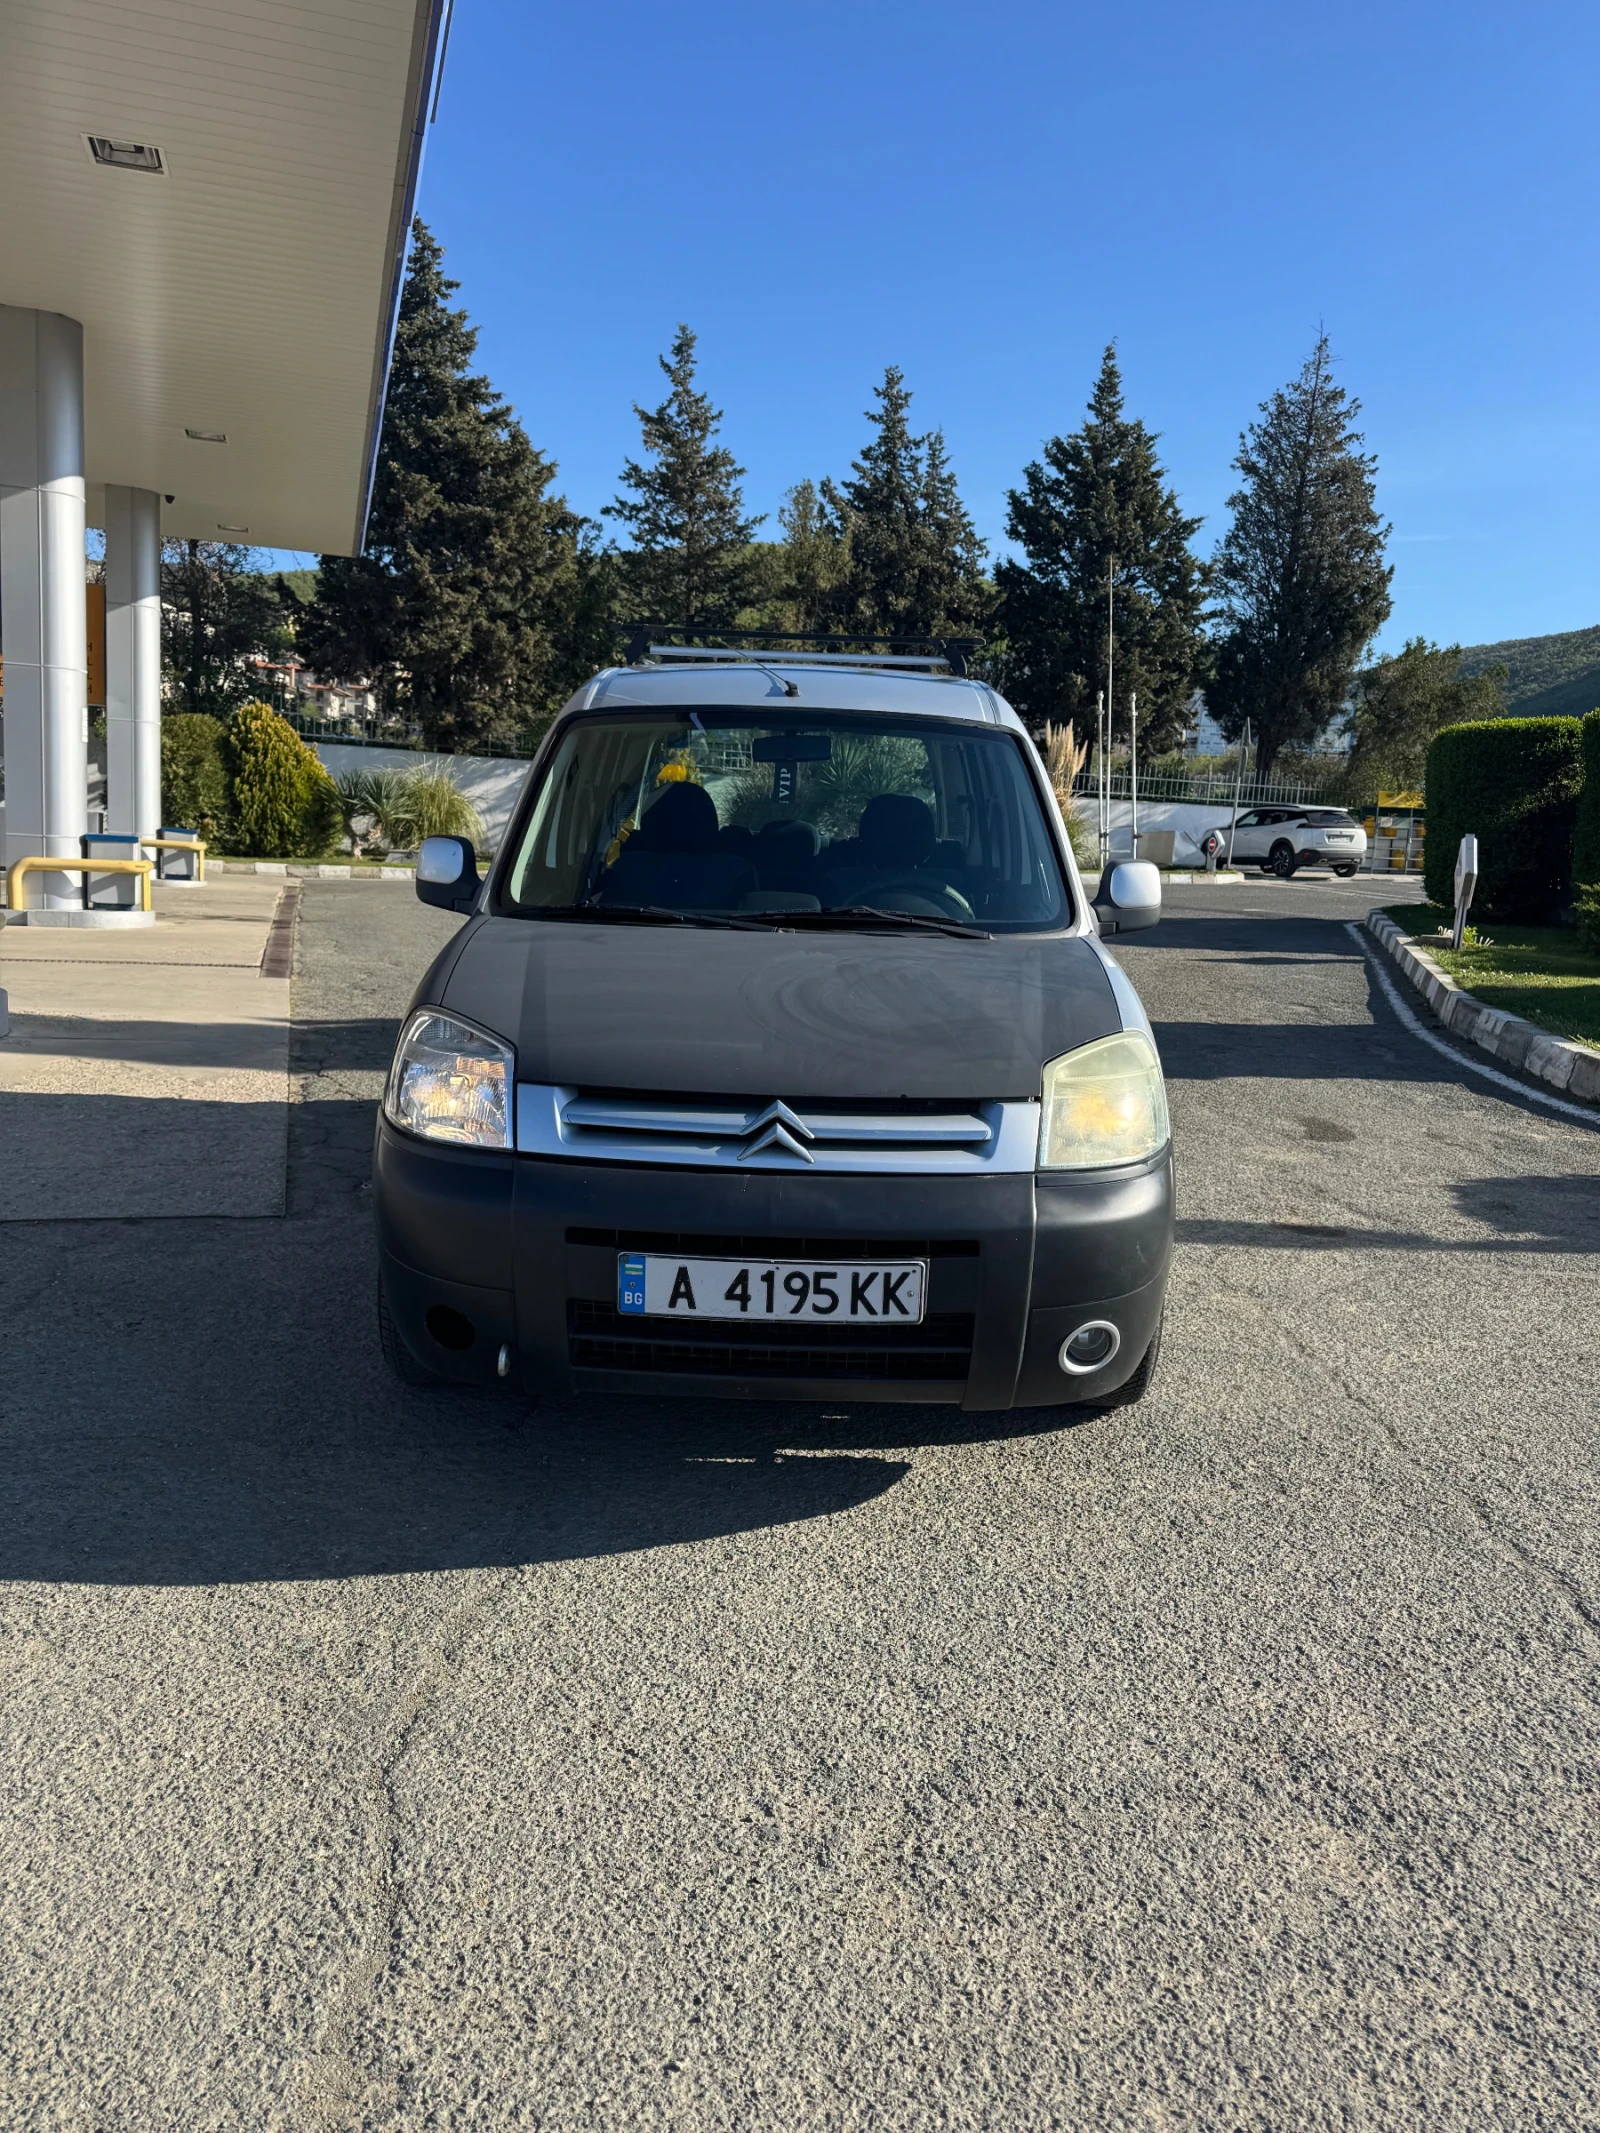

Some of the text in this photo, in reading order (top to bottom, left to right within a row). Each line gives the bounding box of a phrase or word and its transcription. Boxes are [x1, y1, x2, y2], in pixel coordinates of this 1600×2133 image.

[779, 768, 791, 798] VIP
[623, 1290, 643, 1306] BG
[667, 1264, 911, 1316] A 4195 KK
